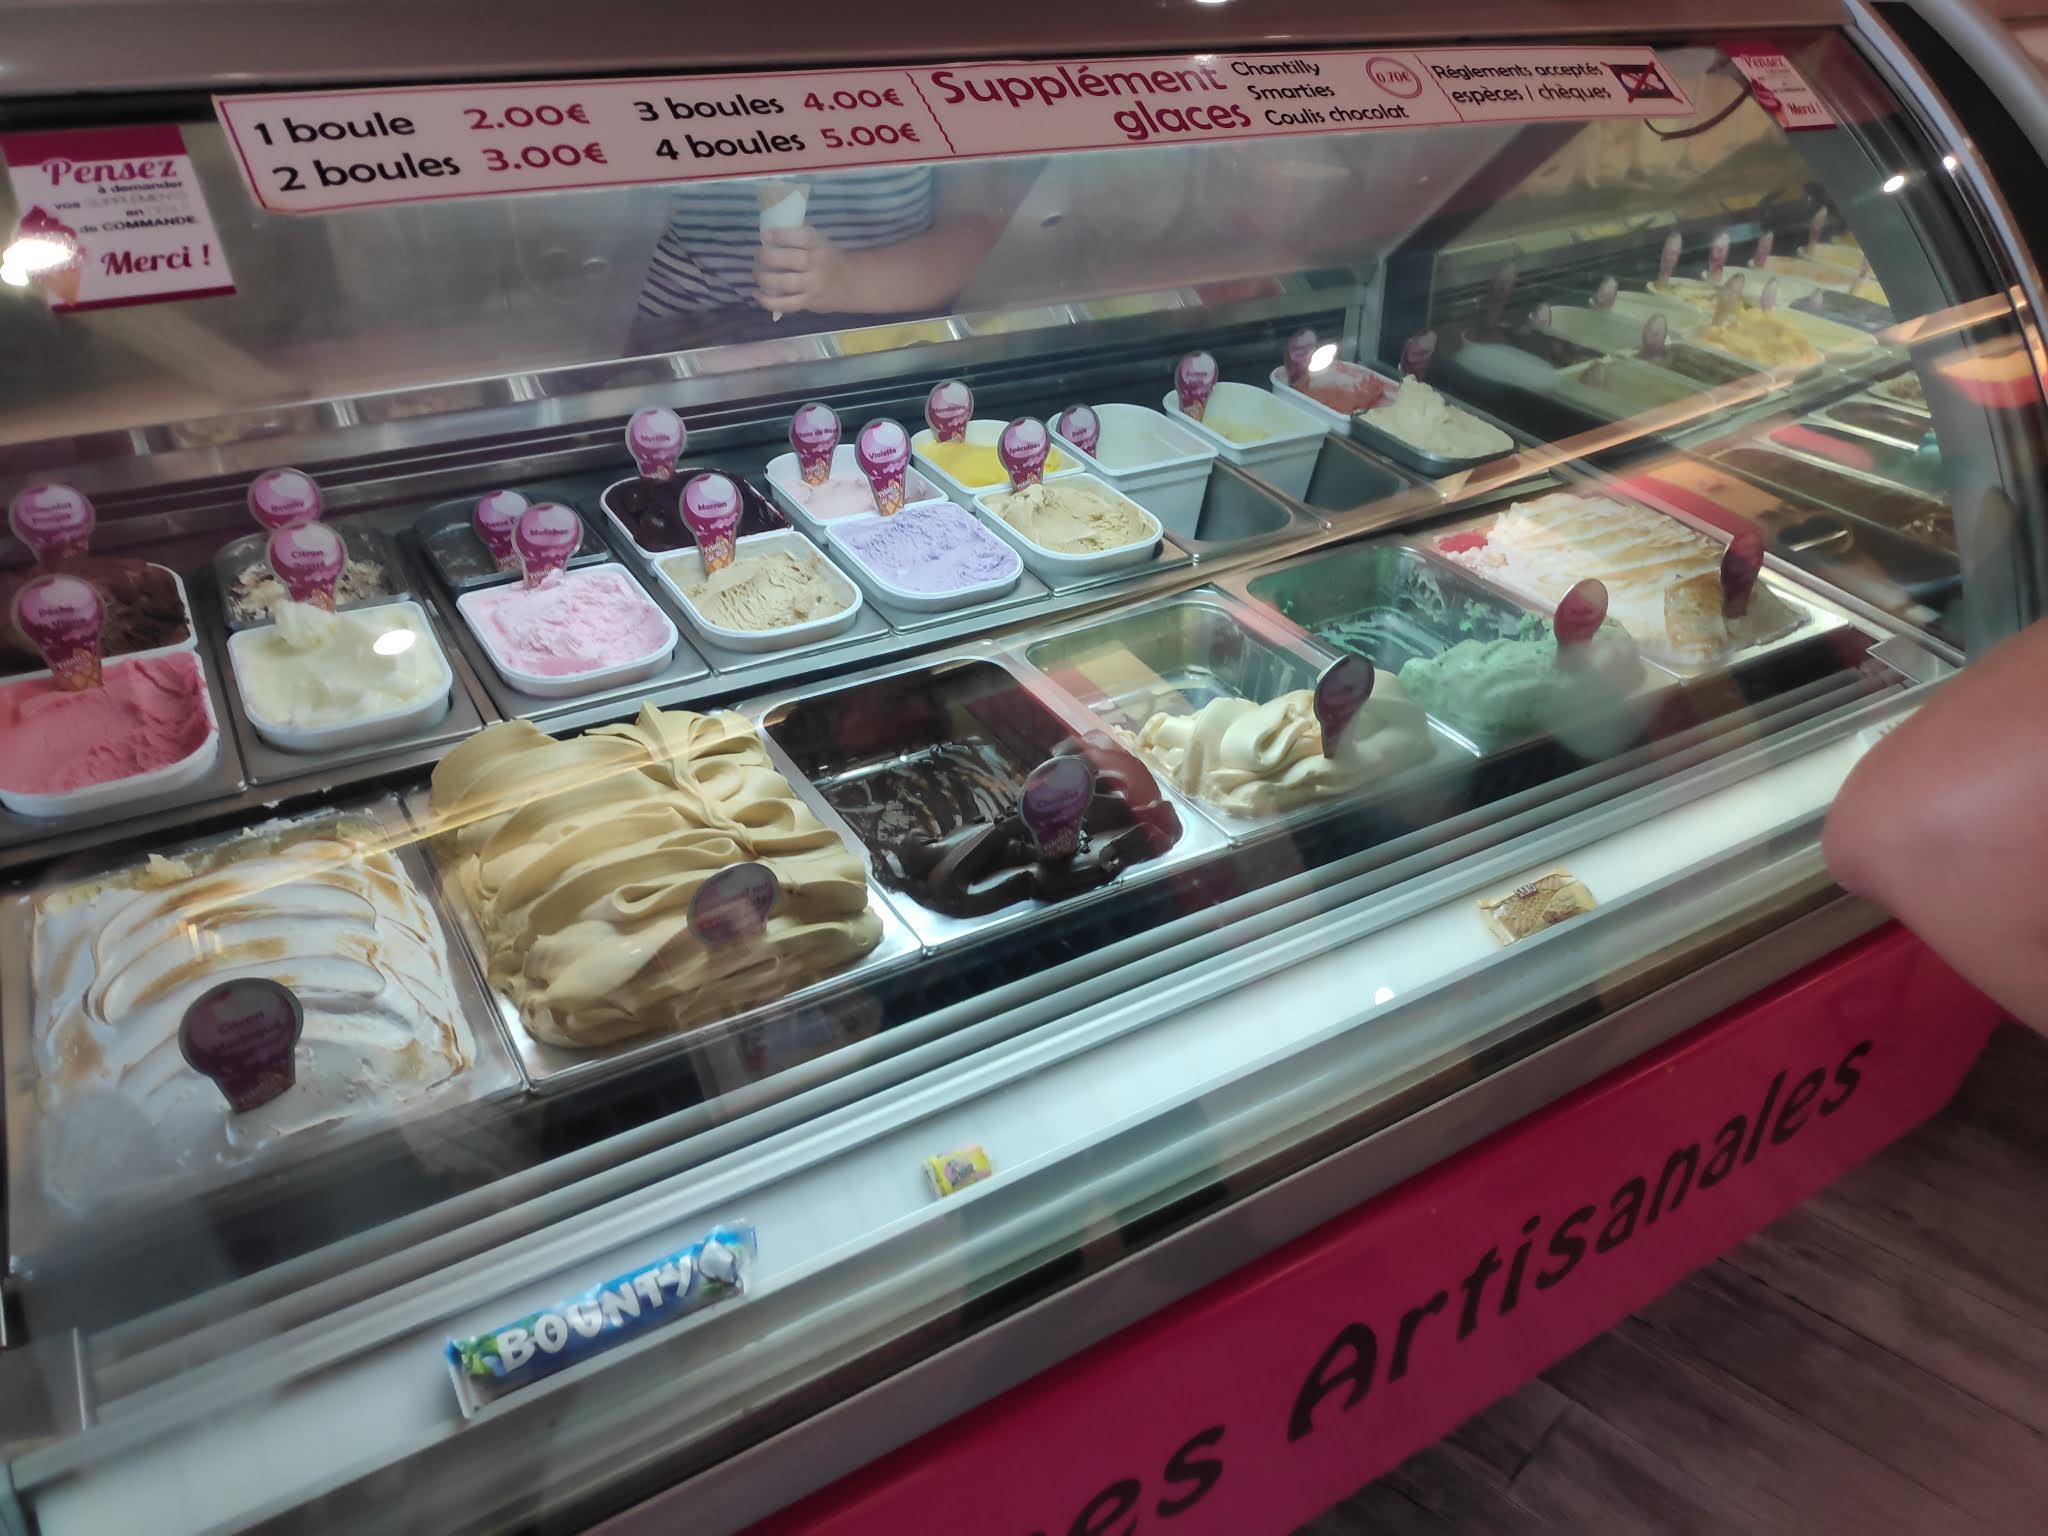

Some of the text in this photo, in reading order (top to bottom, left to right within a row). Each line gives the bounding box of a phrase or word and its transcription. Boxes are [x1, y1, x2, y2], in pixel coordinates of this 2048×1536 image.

[1231, 59, 1321, 77] Chantilly
[1534, 62, 1604, 79] acceptés
[930, 64, 1228, 108] Supplément
[1247, 82, 1336, 101] Smarties
[1452, 85, 1522, 105] espèces
[1538, 83, 1612, 102] chèques
[633, 88, 904, 121] 3 boules 4.00€
[1113, 100, 1252, 141] glaces
[1265, 103, 1410, 127] Coulis chocolat
[254, 103, 590, 144] 1 boule 2.00€
[655, 122, 920, 160] 4 boules 5.00€
[42, 157, 177, 186] Pensez
[272, 142, 608, 191] 2 boules 3.00€
[111, 181, 183, 193] demander
[100, 244, 212, 276] Merci !
[697, 501, 727, 512] Marron
[1286, 1038, 1873, 1443] Artisanales
[496, 1254, 694, 1373] BOUNTY
